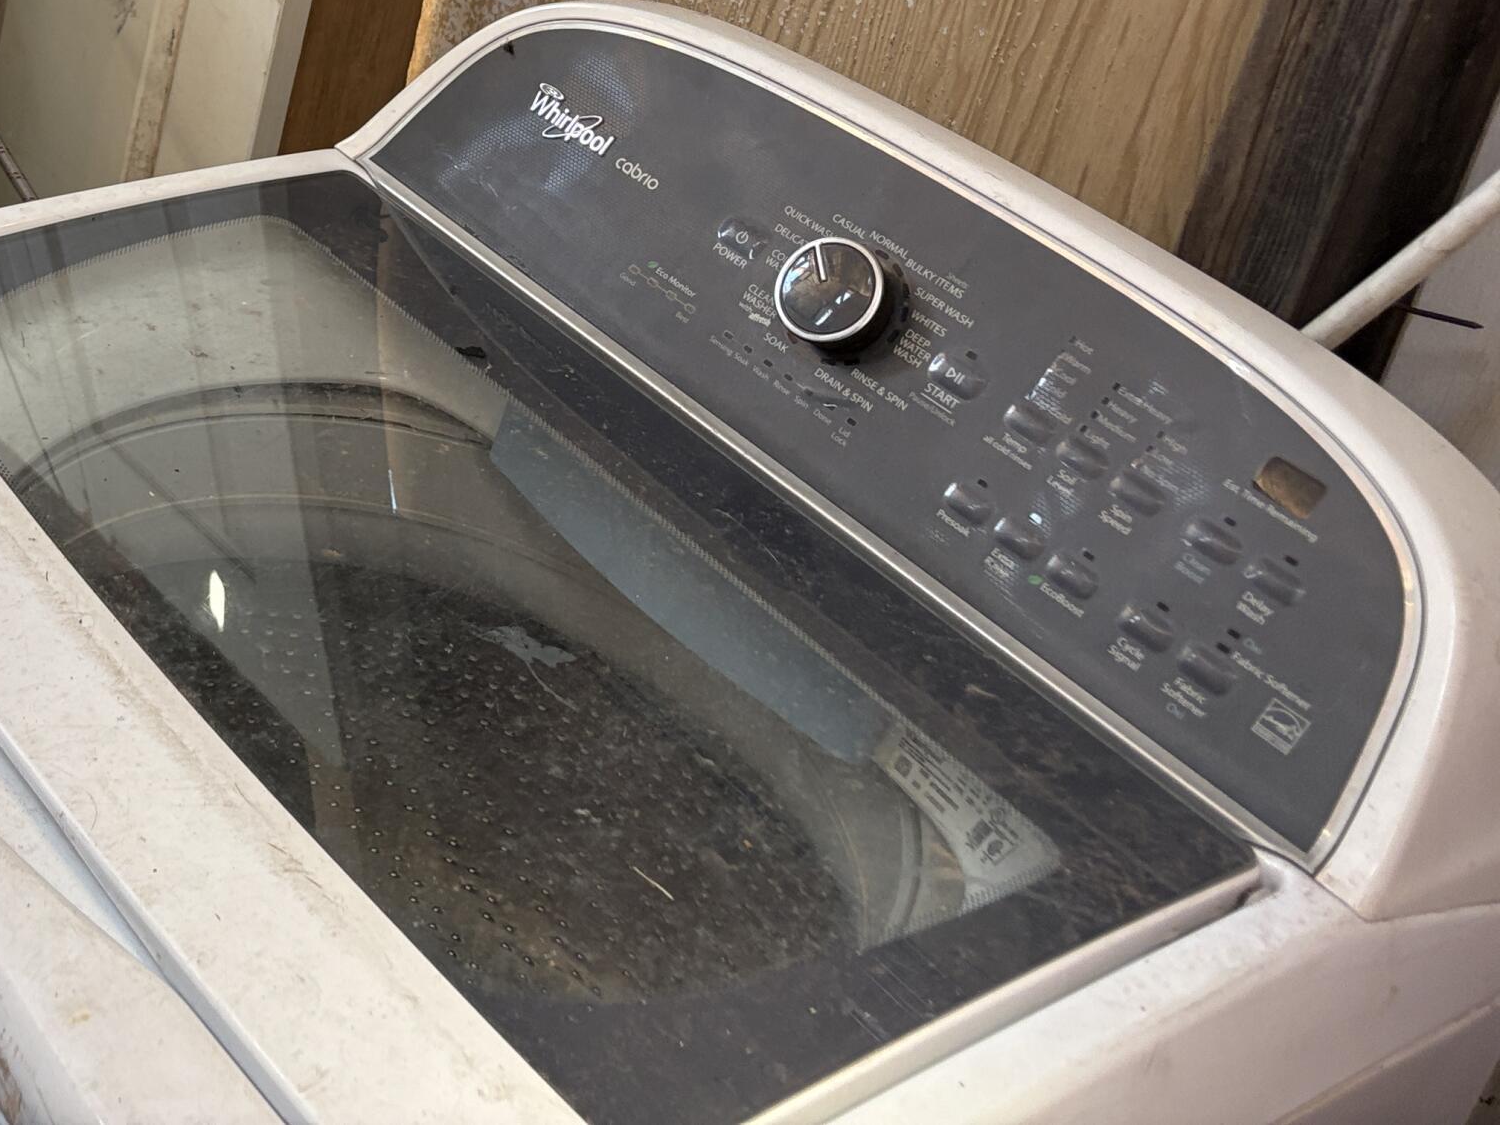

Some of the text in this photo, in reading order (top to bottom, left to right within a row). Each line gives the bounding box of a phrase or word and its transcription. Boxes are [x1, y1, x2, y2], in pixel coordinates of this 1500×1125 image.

[530, 90, 615, 156] Whirlpool
[615, 157, 659, 190] cabrio
[784, 205, 812, 227] QUICK
[832, 213, 867, 240] CASUAL
[712, 242, 749, 270] POWER
[869, 230, 909, 260] NORMAL
[655, 266, 697, 298] Eco Monitor
[904, 258, 965, 300] BULKY ITEMS
[743, 290, 777, 319] WASHER
[748, 284, 774, 306] CLEAN
[914, 286, 975, 329] SUPER WASH
[911, 309, 948, 338] WHITES
[763, 332, 790, 354] SOAK
[900, 336, 932, 363] WATER
[905, 328, 931, 349] DEEP
[893, 345, 923, 369] WASH
[793, 394, 809, 410] Spin
[814, 367, 874, 413] DRAIN & SPIN
[851, 367, 909, 412] RINSE & SPIN
[924, 382, 961, 409] START
[1002, 432, 1028, 454] Temp
[1242, 488, 1266, 509] Time
[936, 508, 971, 538] Presoak
[1040, 582, 1085, 618] EcoBoost
[1242, 590, 1275, 616] Delay
[1107, 644, 1141, 672] Signal
[1117, 636, 1145, 661] Cycle
[1173, 677, 1207, 705] Fabric
[1231, 651, 1312, 711] Fabric Softener
[1160, 682, 1208, 718] Softener
